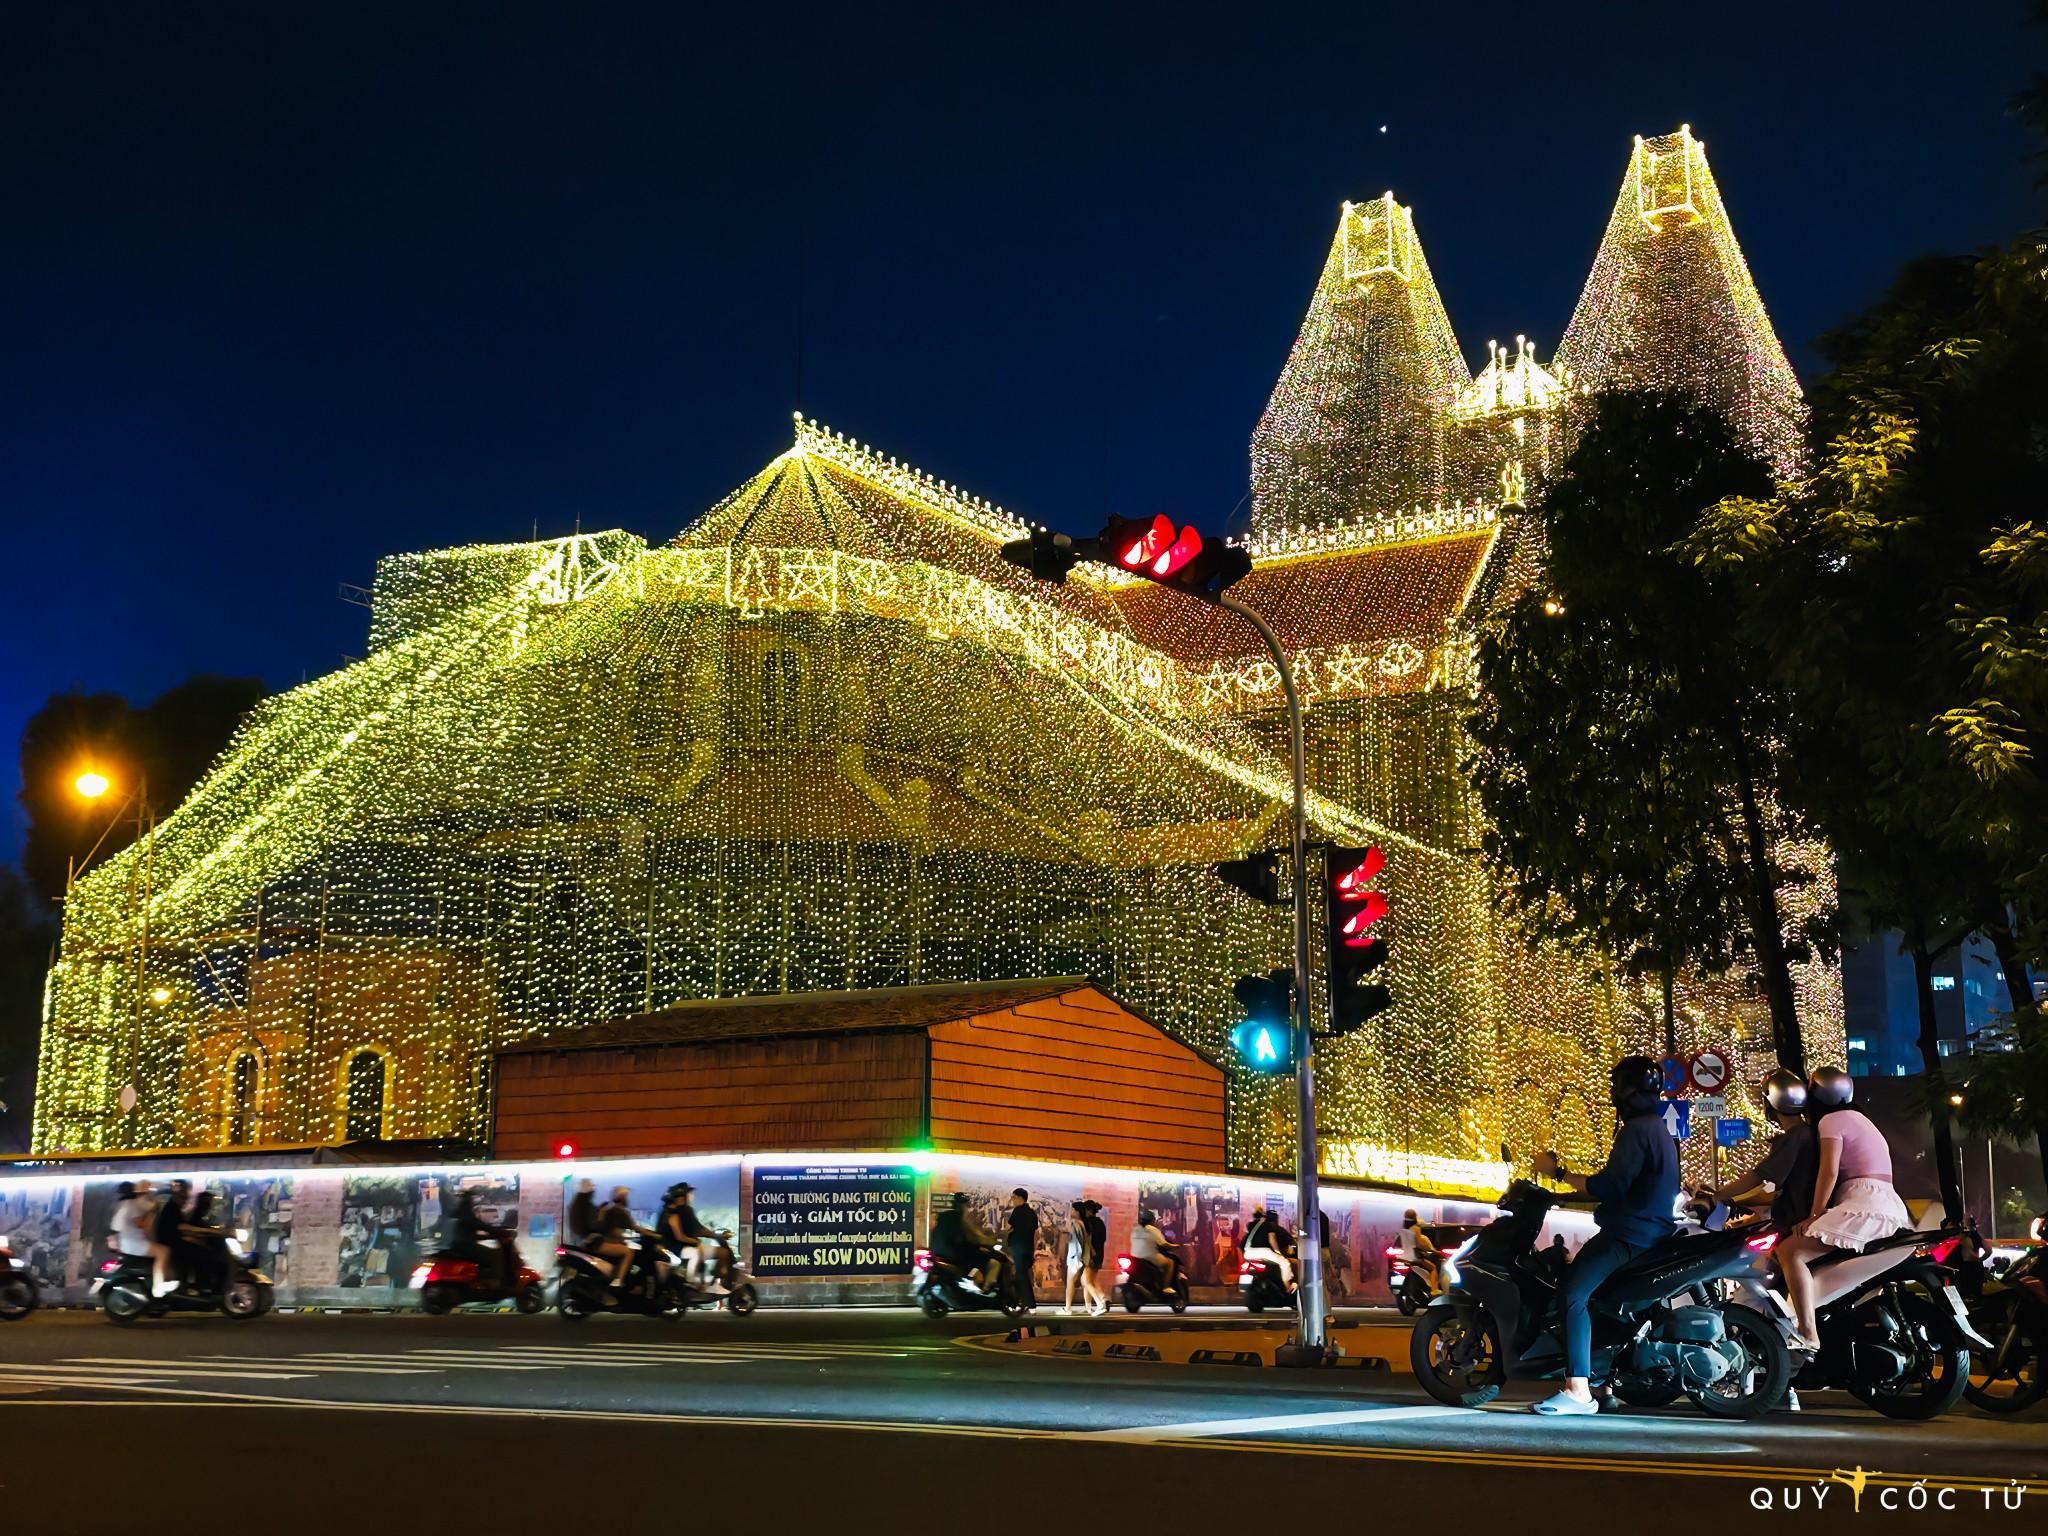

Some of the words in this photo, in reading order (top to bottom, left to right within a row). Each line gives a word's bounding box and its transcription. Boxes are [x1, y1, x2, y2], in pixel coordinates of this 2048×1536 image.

[863, 1192, 880, 1203] THI
[882, 1190, 911, 1203] CÔNG
[757, 1211, 787, 1224] CHÚ
[790, 1210, 803, 1224] Ý:
[807, 1206, 844, 1223] GIẢM
[846, 1206, 875, 1223] TỐC
[838, 1231, 867, 1245] Conception
[868, 1231, 892, 1243] Cathedral
[893, 1230, 913, 1243] Basilica
[758, 1254, 811, 1266] ATTENTION:
[813, 1248, 853, 1266] SLOW
[856, 1247, 900, 1265] DOWN
